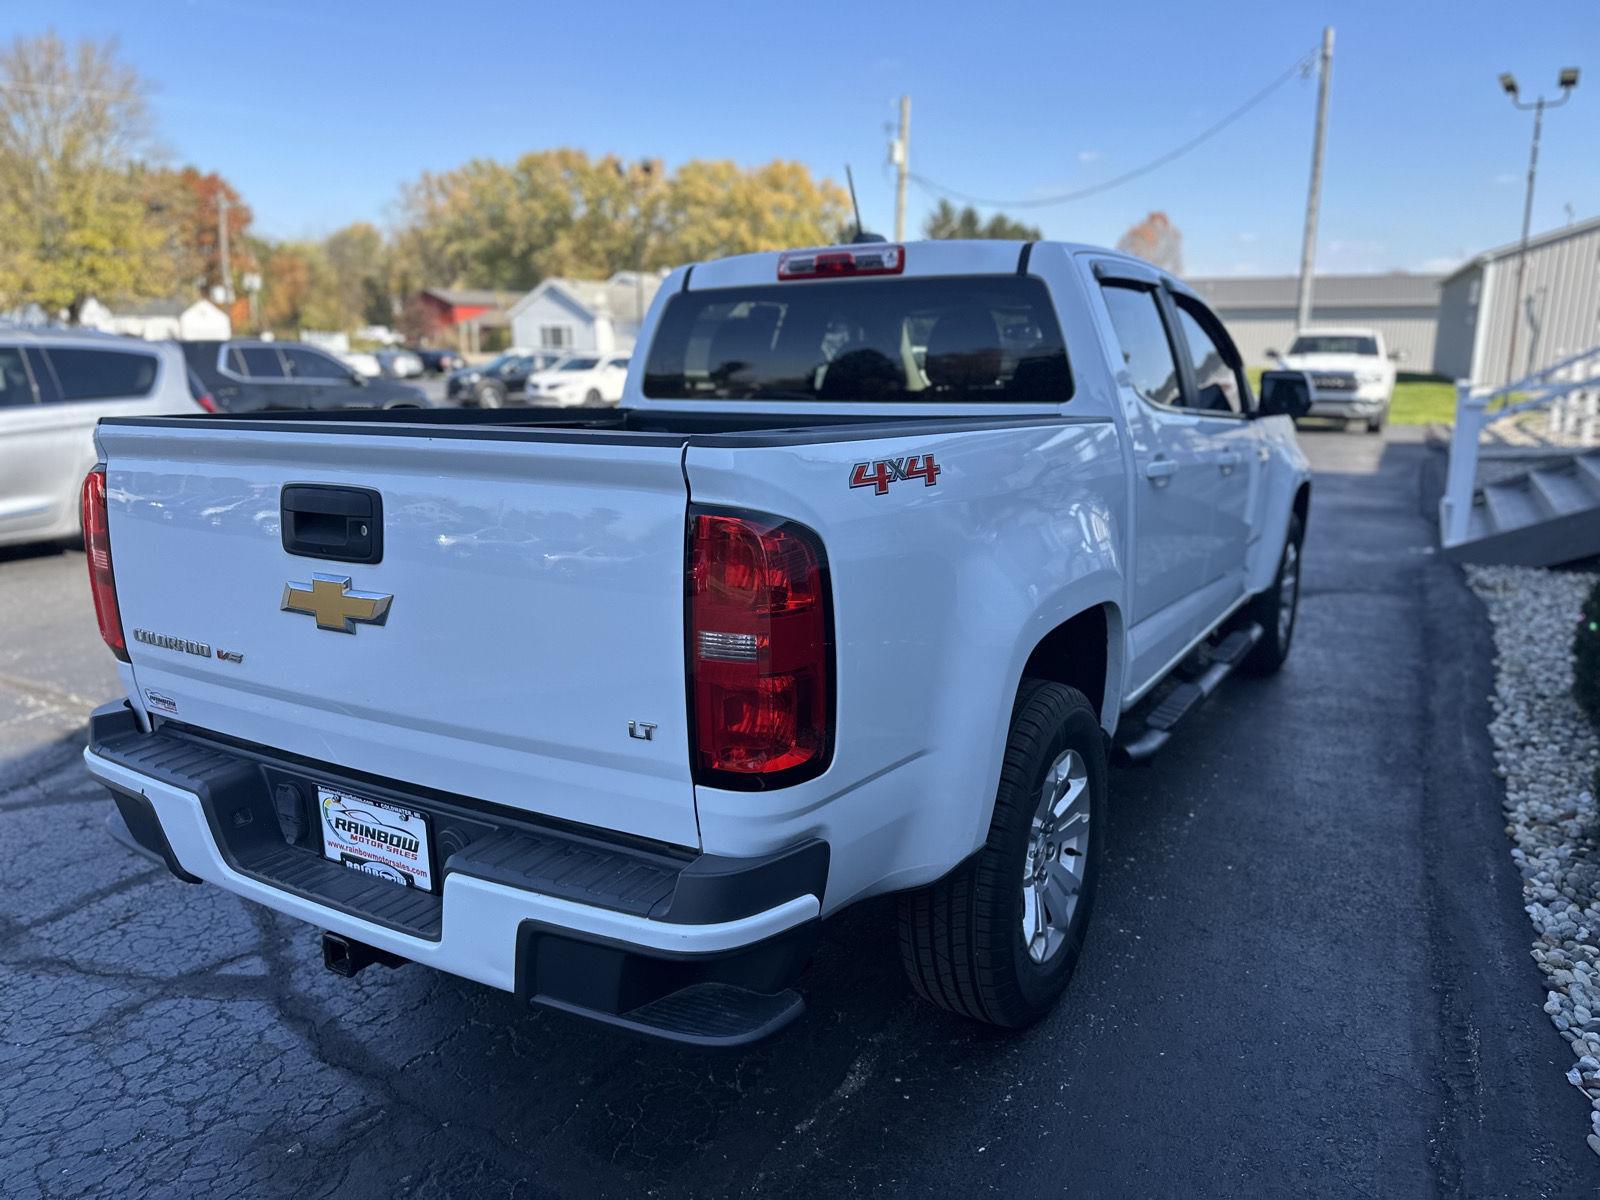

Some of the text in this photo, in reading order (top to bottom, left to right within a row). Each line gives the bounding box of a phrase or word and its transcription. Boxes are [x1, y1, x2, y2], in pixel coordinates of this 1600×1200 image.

[133, 628, 211, 658] COLORADO
[628, 720, 658, 741] LT
[335, 817, 419, 853] RAINBOW
[350, 834, 418, 861] MOTOR SALES
[327, 840, 428, 878] www.rainbowmotorsales.com
